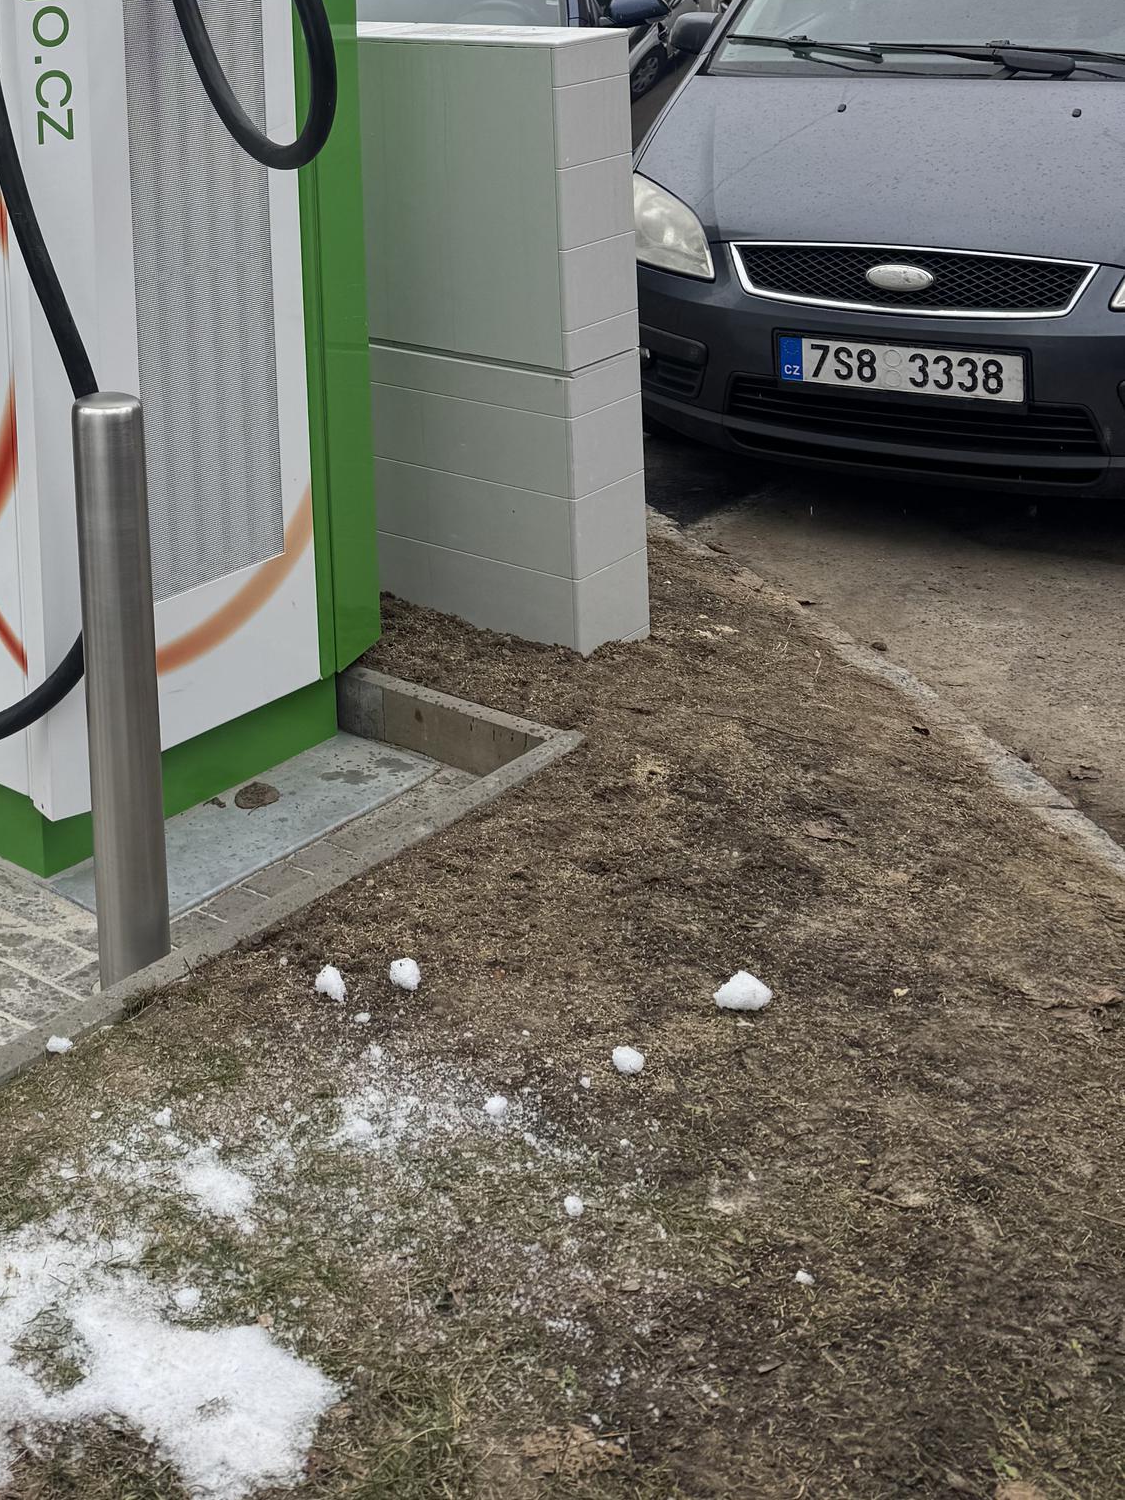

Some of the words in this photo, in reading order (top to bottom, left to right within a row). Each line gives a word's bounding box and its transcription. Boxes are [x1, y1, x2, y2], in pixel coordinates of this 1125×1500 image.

[784, 364, 801, 377] CZ
[810, 344, 877, 384] 7S8
[908, 353, 1004, 395] 3338
